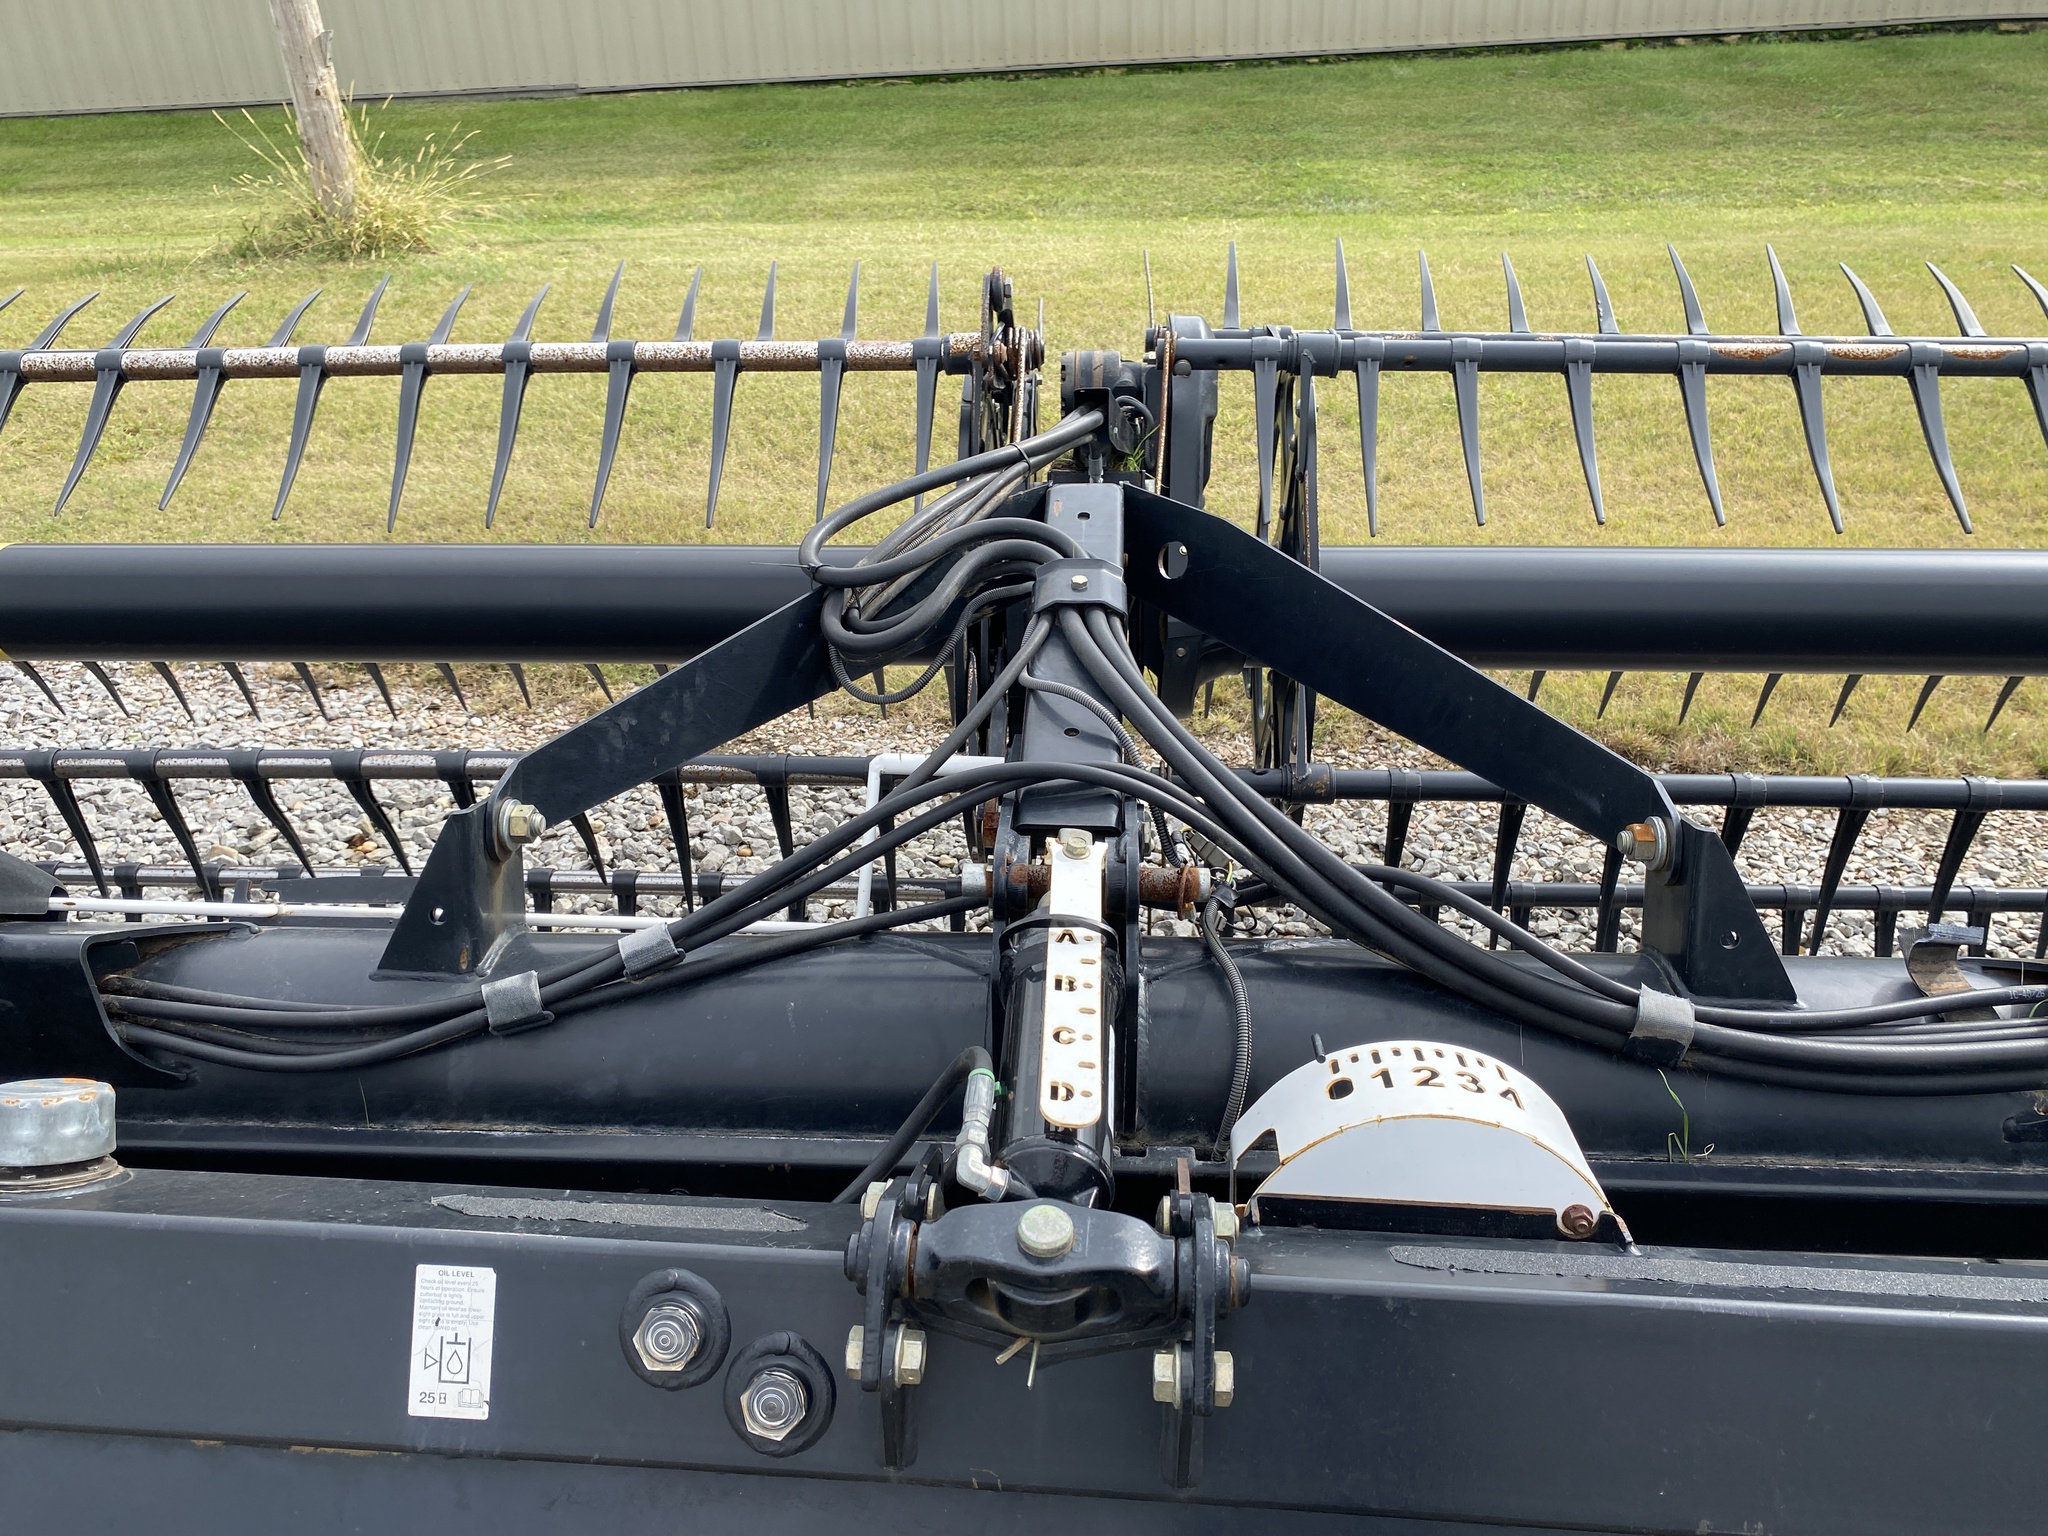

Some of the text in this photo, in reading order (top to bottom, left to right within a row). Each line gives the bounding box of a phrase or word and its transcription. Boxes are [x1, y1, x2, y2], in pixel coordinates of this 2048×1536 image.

[1055, 929, 1079, 945] A
[1054, 974, 1078, 992] B
[1052, 1026, 1076, 1044] C
[1049, 1080, 1076, 1102] D
[1327, 1065, 1526, 1111] 0 1 2 3 4
[452, 1270, 475, 1278] LEVEL
[419, 1391, 436, 1404] 25
